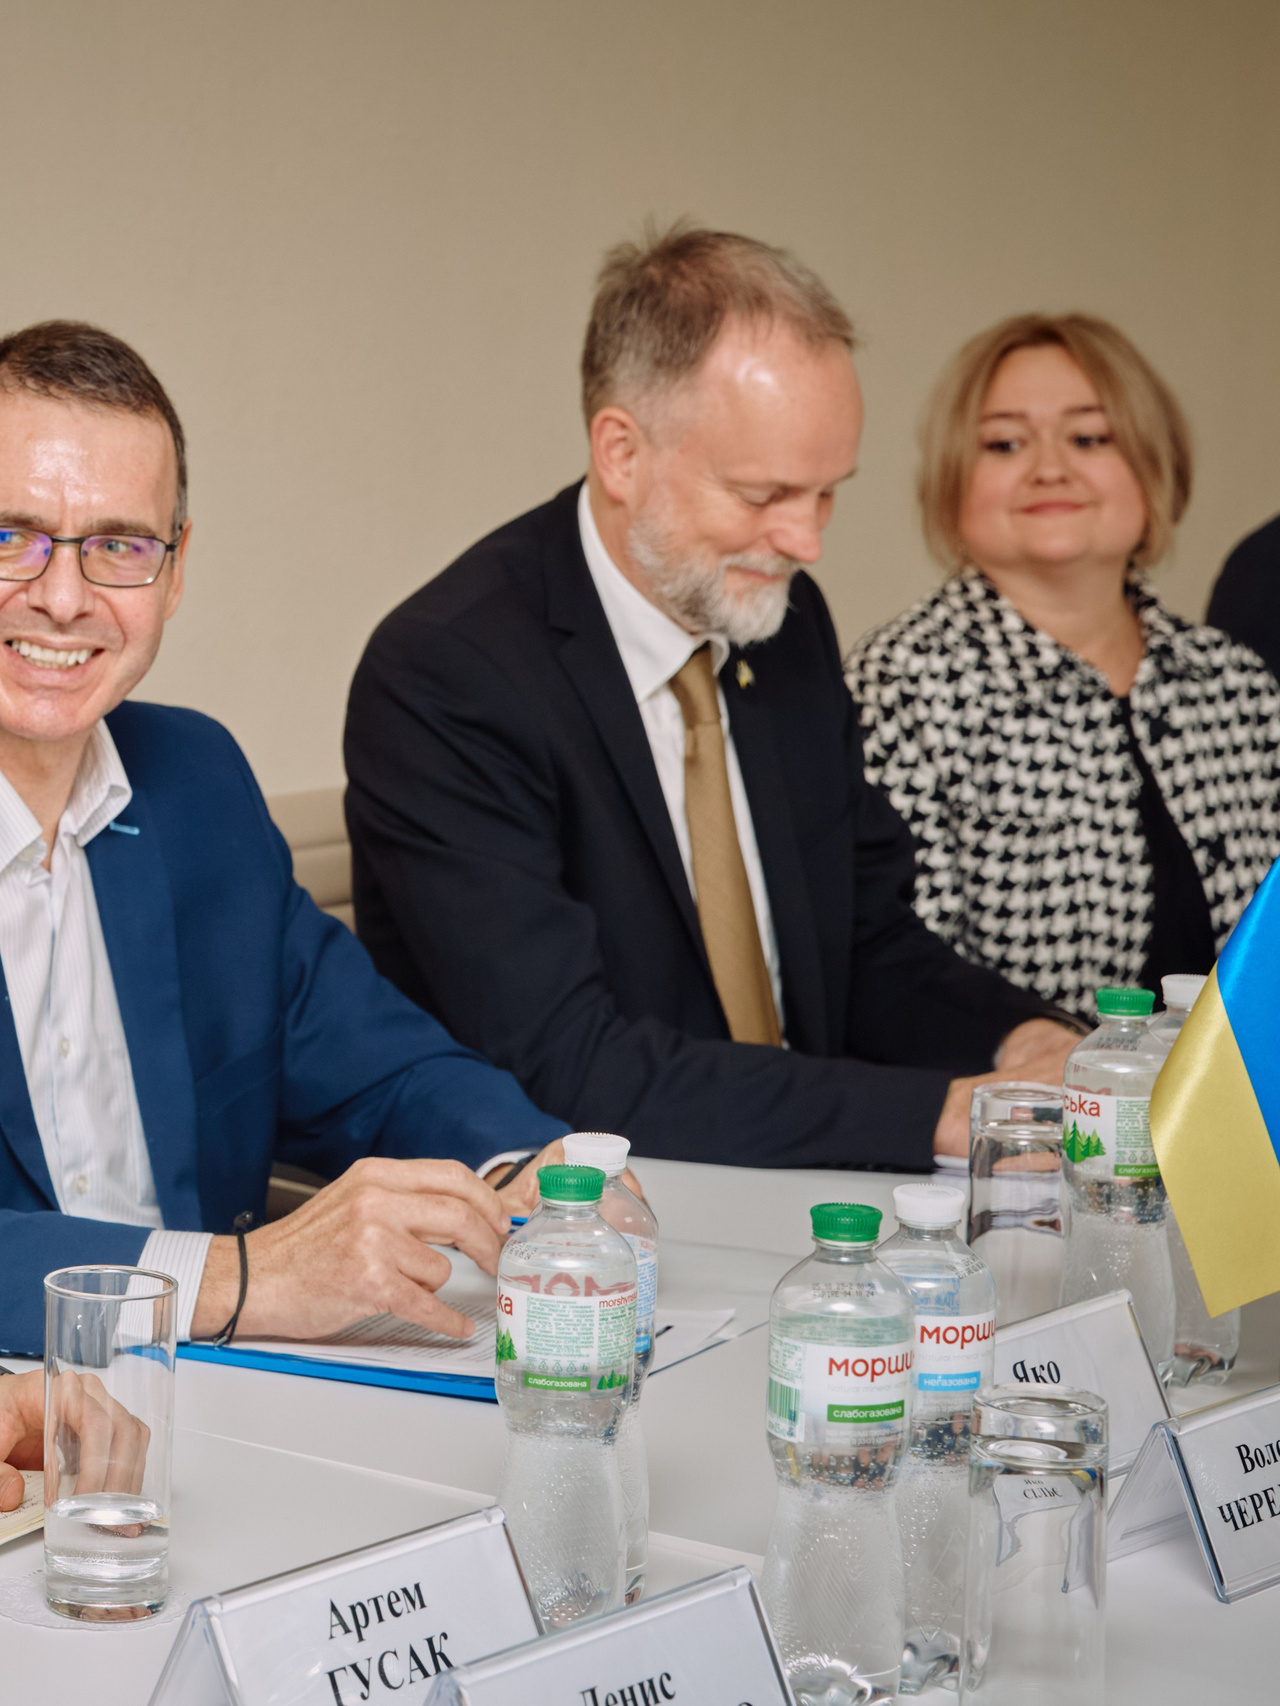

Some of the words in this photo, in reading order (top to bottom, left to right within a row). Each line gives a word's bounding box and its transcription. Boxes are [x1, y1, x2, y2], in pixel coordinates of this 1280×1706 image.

[527, 1377, 587, 1388] слабогазована
[832, 1405, 902, 1419] слабогазована
[1217, 1484, 1280, 1532] ЧЕРЕ
[327, 1581, 427, 1643] Артем
[324, 1631, 454, 1706] ГУСАК
